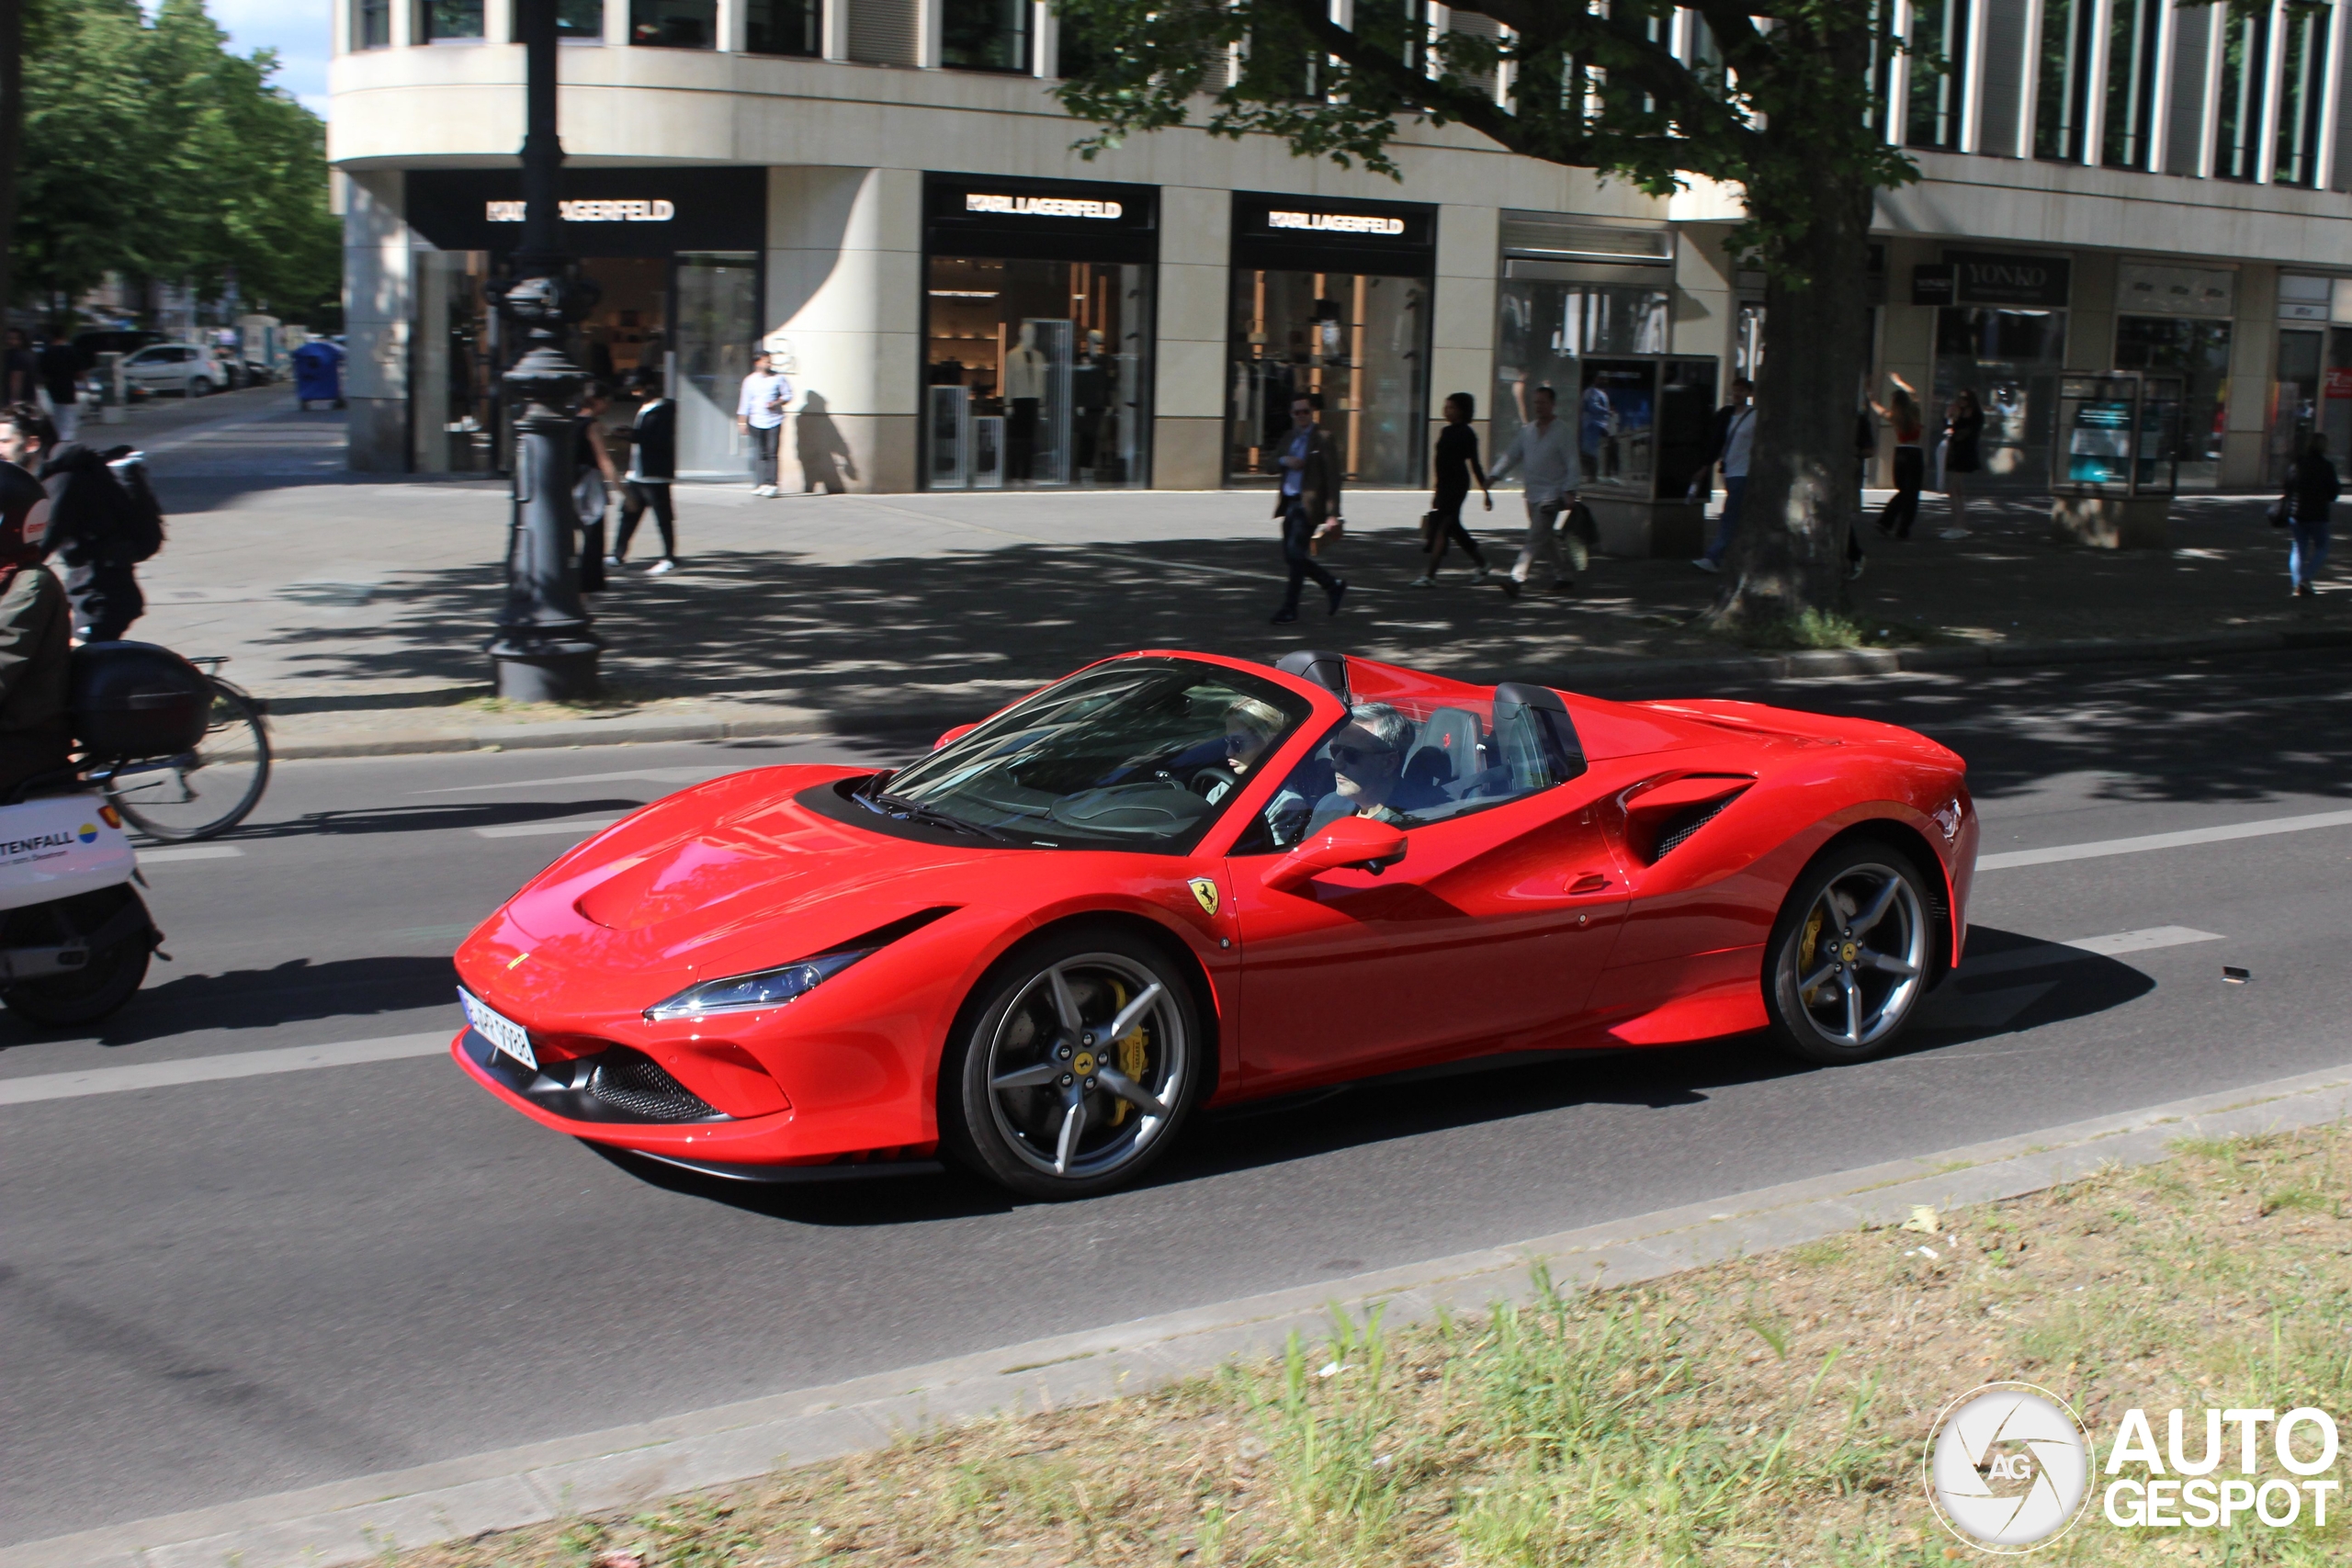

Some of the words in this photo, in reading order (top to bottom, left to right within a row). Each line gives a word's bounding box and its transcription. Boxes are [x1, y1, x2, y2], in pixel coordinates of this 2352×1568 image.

[486, 200, 527, 221] KA
[558, 199, 674, 221] AGERFELD
[966, 194, 1017, 214] KARL
[1016, 197, 1123, 220] LAGERFELD
[1269, 210, 1312, 229] KARL
[1312, 214, 1405, 235] LAGERFELD
